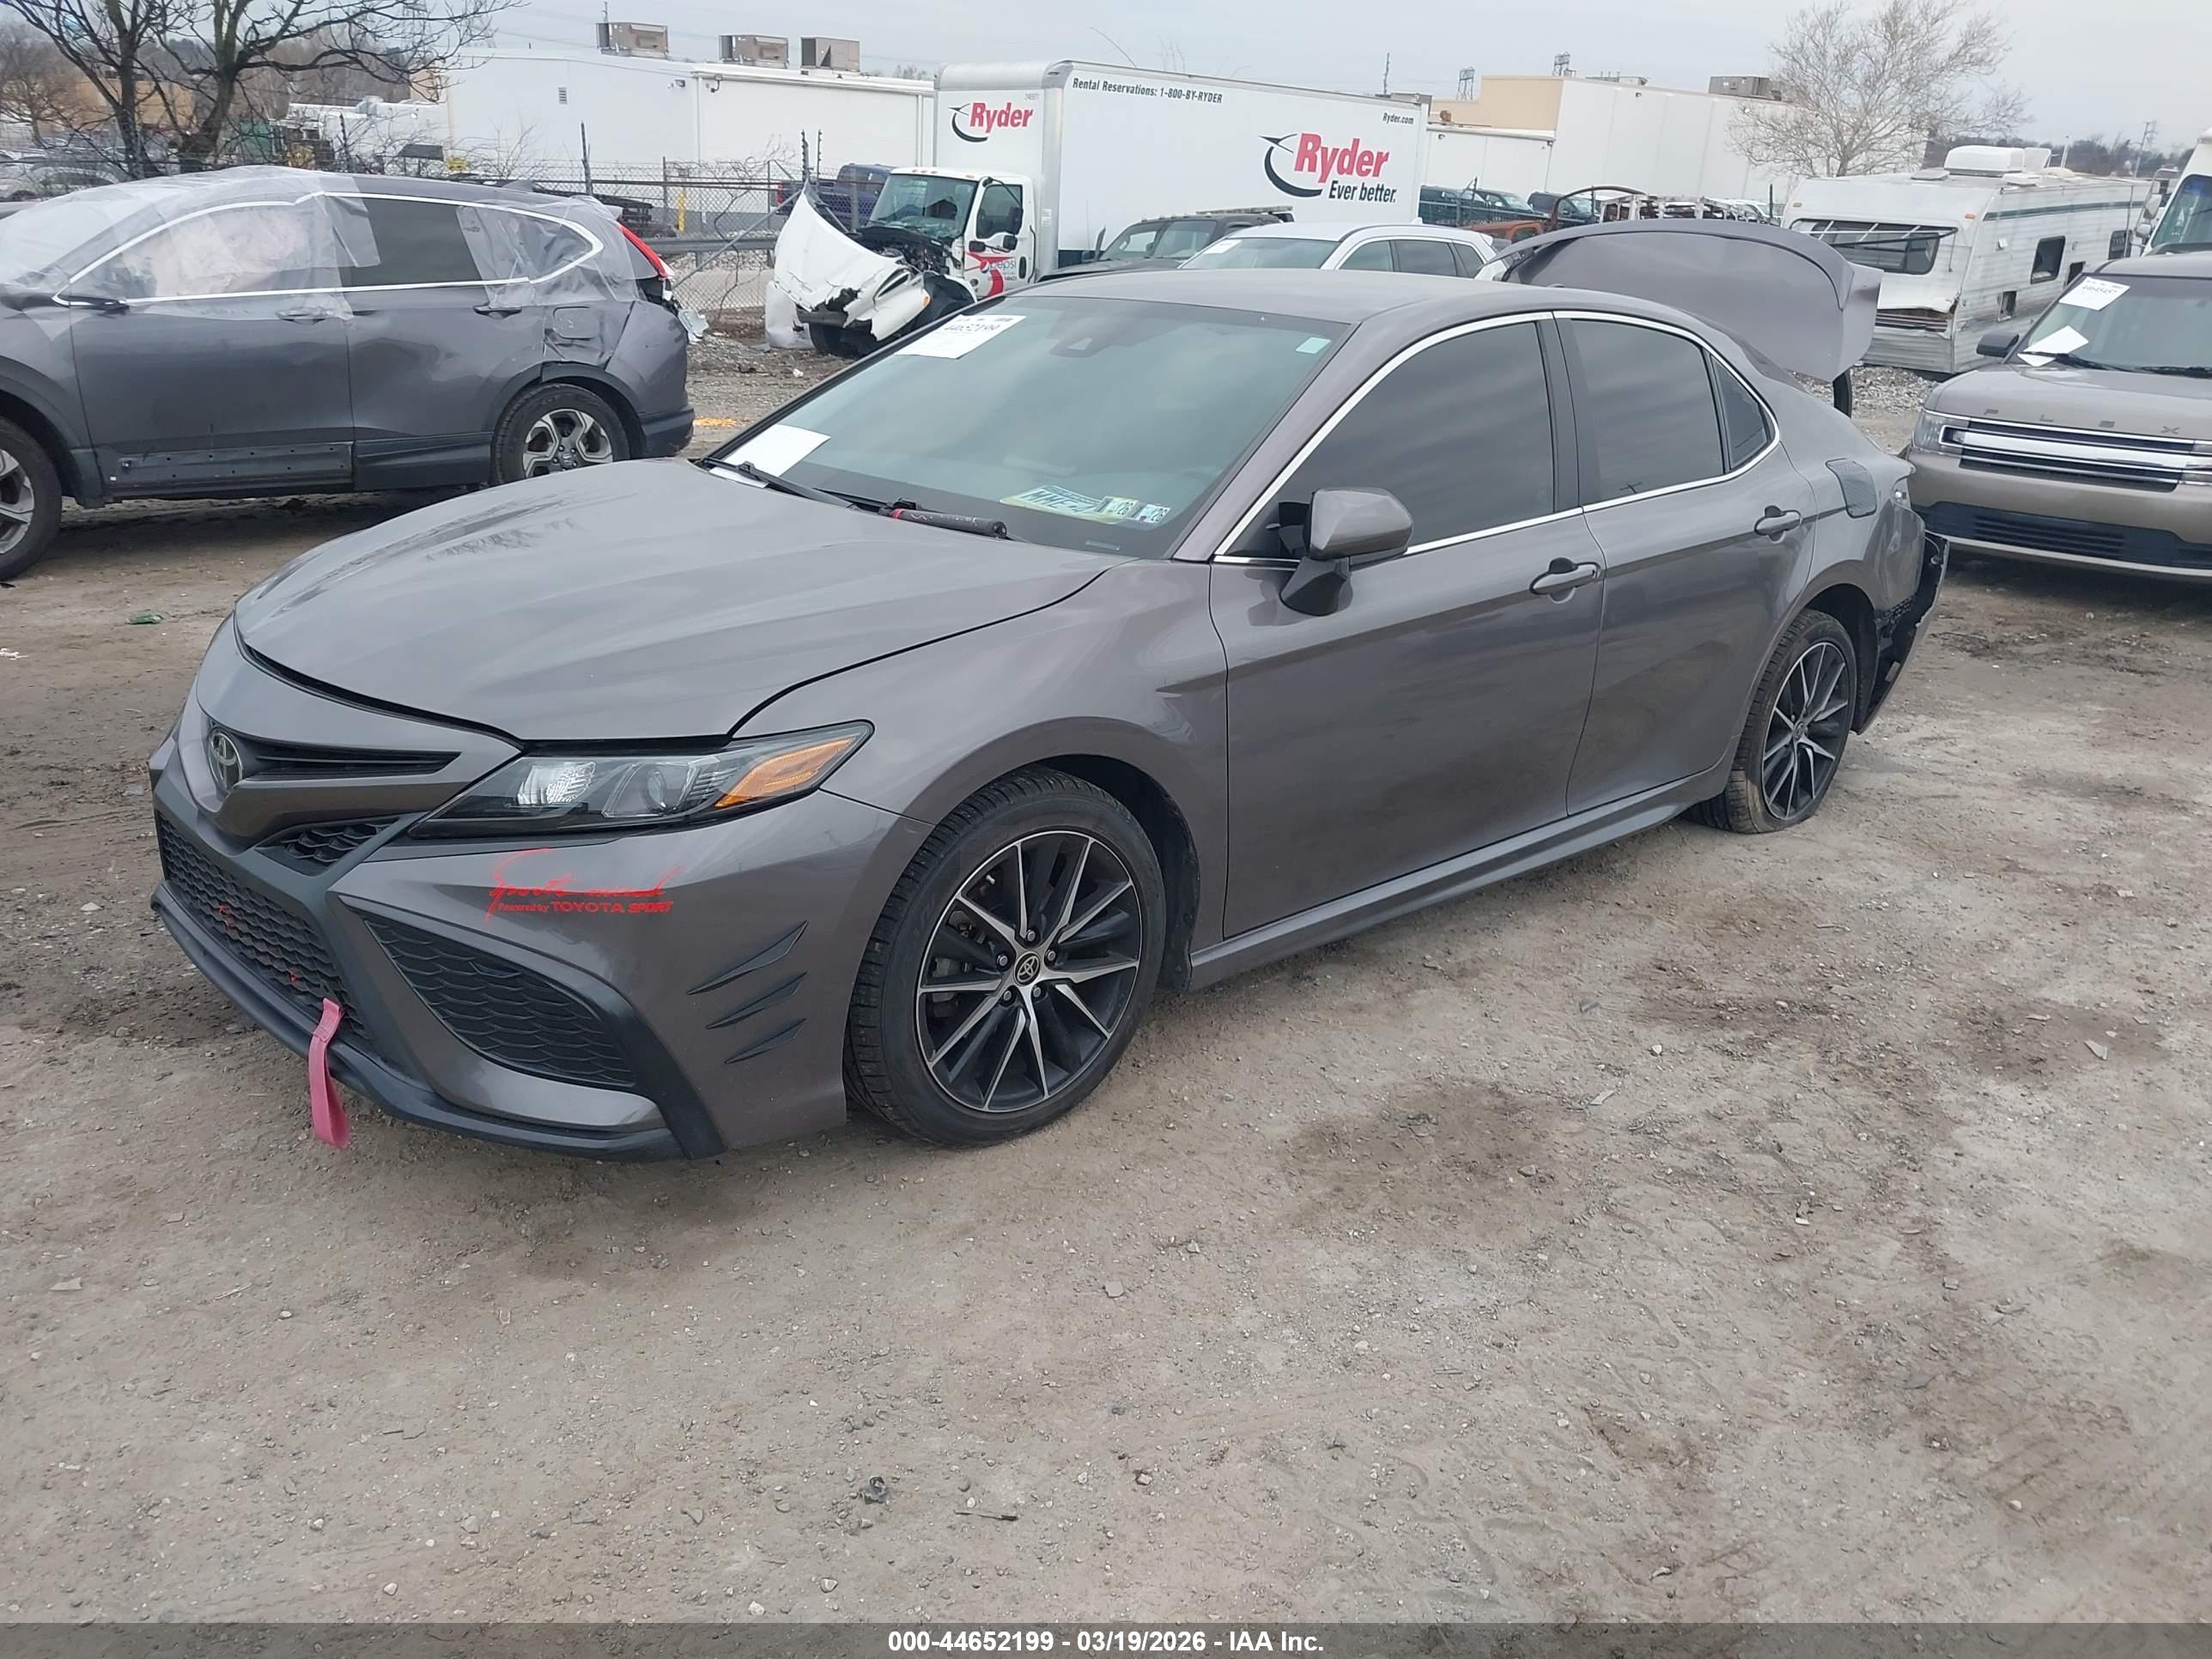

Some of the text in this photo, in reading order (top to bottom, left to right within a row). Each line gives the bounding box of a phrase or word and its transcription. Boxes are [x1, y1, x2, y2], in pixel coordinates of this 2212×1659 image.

[1073, 77, 1223, 103] Rental Reservations: 1-800-BY-RYDER
[969, 102, 1033, 133] Ryder
[1382, 112, 1414, 125] Ryder.com
[1294, 133, 1389, 183] Ryder
[1328, 179, 1397, 203] Ever better.
[989, 258, 1017, 271] pepsi
[1984, 409, 2180, 434] FLEX
[498, 901, 674, 915] Powered by TOYOTA SPORT
